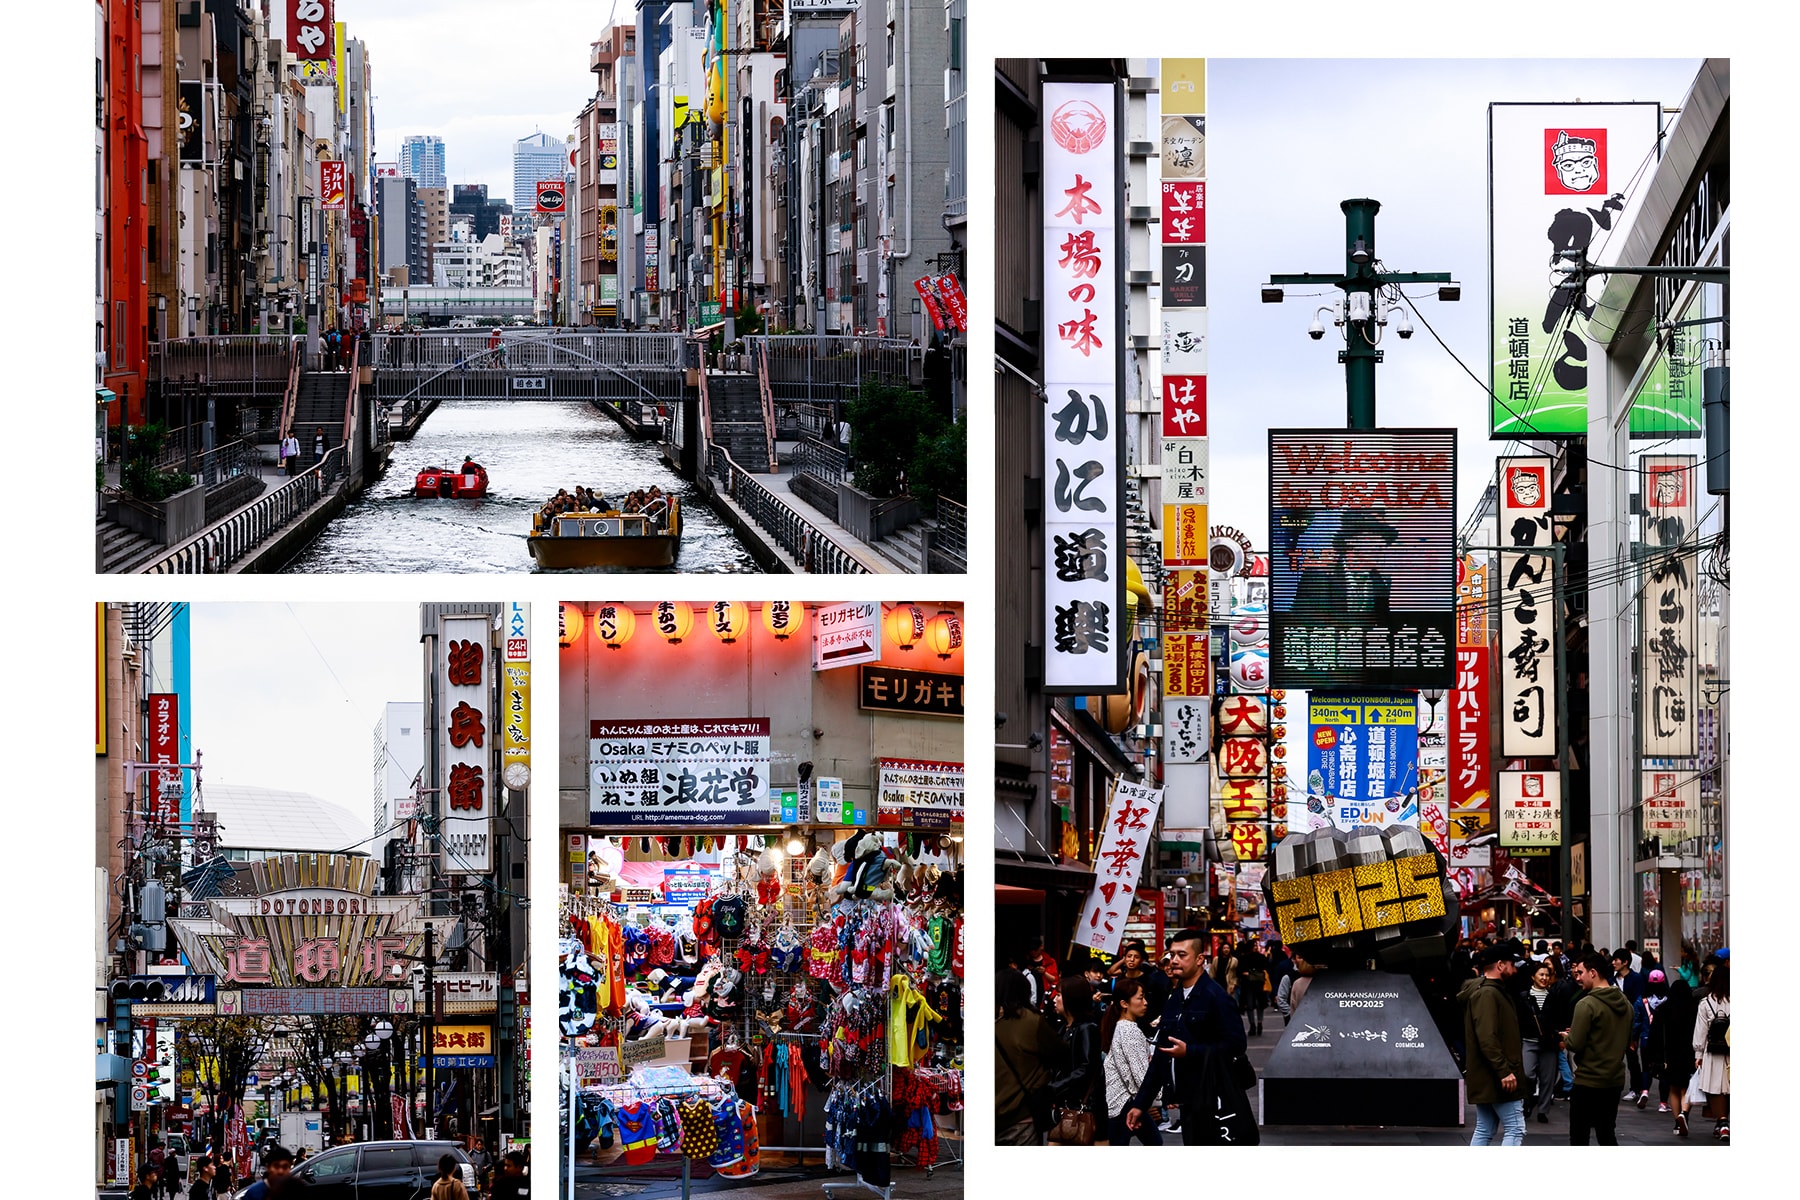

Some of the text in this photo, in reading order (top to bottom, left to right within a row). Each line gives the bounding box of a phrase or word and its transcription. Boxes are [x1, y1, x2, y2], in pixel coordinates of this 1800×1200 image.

[323, 168, 332, 198] ドラッグ
[332, 163, 342, 191] ツルハ
[1163, 184, 1175, 193] 8F
[501, 216, 511, 236] かに
[1179, 249, 1190, 258] 7F
[1055, 174, 1103, 357] 本場の味
[1175, 262, 1195, 282] 刀
[1508, 316, 1529, 401] 道頓堀店
[1169, 378, 1201, 434] はや
[1164, 443, 1176, 452] 4F
[1277, 441, 1449, 475] Welcome
[1177, 445, 1205, 499] 白木屋
[1320, 481, 1450, 509] OSAKA
[820, 604, 874, 627] モリガキビル
[1507, 516, 1550, 738] がんこ寿司
[508, 641, 527, 650] 24H
[1394, 697, 1413, 705] Japan
[157, 699, 170, 746] カラオケ
[1312, 708, 1339, 717] 340m
[1386, 709, 1413, 718] 240m
[1457, 651, 1481, 789] ツルハドラッグ
[1316, 736, 1336, 746] OPEN!
[1317, 730, 1333, 739] NEW
[600, 740, 759, 756] Osaka ミナミのペット服
[600, 768, 659, 785] いぬ組
[662, 767, 759, 806] 浪花堂
[1221, 696, 1267, 861] 大阪王将
[601, 790, 659, 807] ねこ組
[883, 789, 905, 803] Osaka
[645, 813, 726, 822] http://amemura-dog.com/
[1340, 807, 1384, 823] EDION
[1511, 829, 1559, 841] 寿司・和食
[1089, 799, 1150, 932] 松葉かに
[261, 899, 368, 915] DOTONBORI
[1271, 852, 1447, 945] 2025
[225, 937, 407, 983] 道頓堀
[1339, 1000, 1384, 1008] EXPO2025
